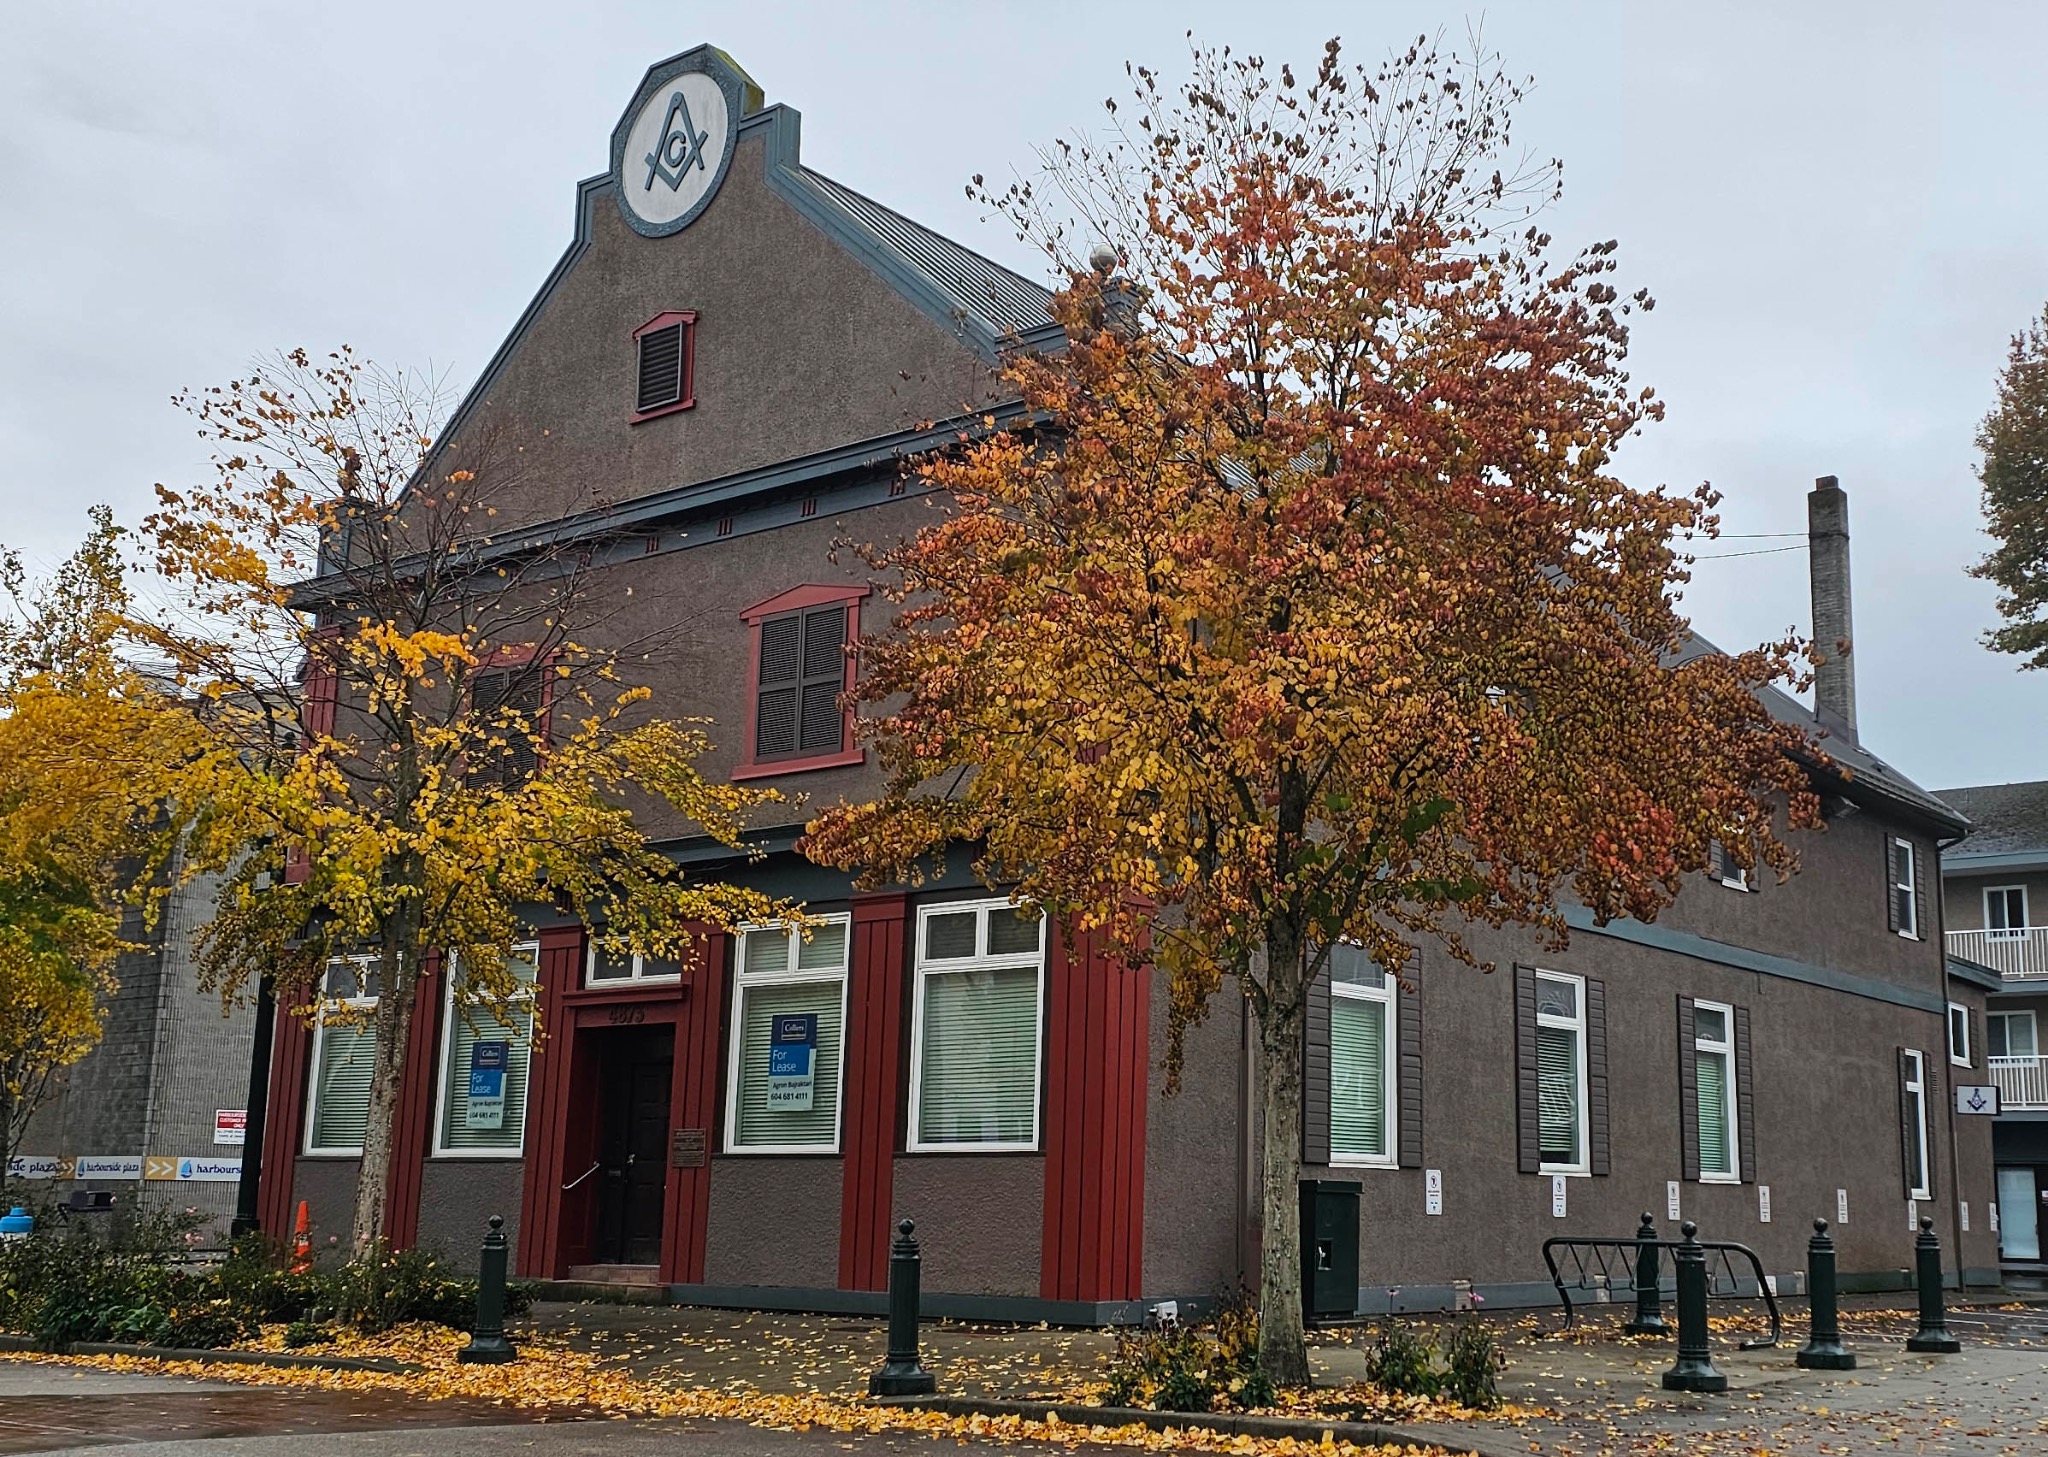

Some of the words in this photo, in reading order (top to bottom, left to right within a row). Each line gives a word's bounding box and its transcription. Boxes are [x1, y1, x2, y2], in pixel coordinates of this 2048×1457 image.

[772, 1049, 787, 1060] For
[772, 1061, 796, 1072] Lease
[472, 1073, 484, 1083] For
[471, 1084, 491, 1094] Lease
[771, 1093, 782, 1101] 604
[783, 1093, 794, 1101] 681
[795, 1092, 808, 1100] 4111
[86, 1162, 121, 1171] harbourside
[123, 1162, 139, 1173] plaza
[196, 1163, 242, 1174] harbours
